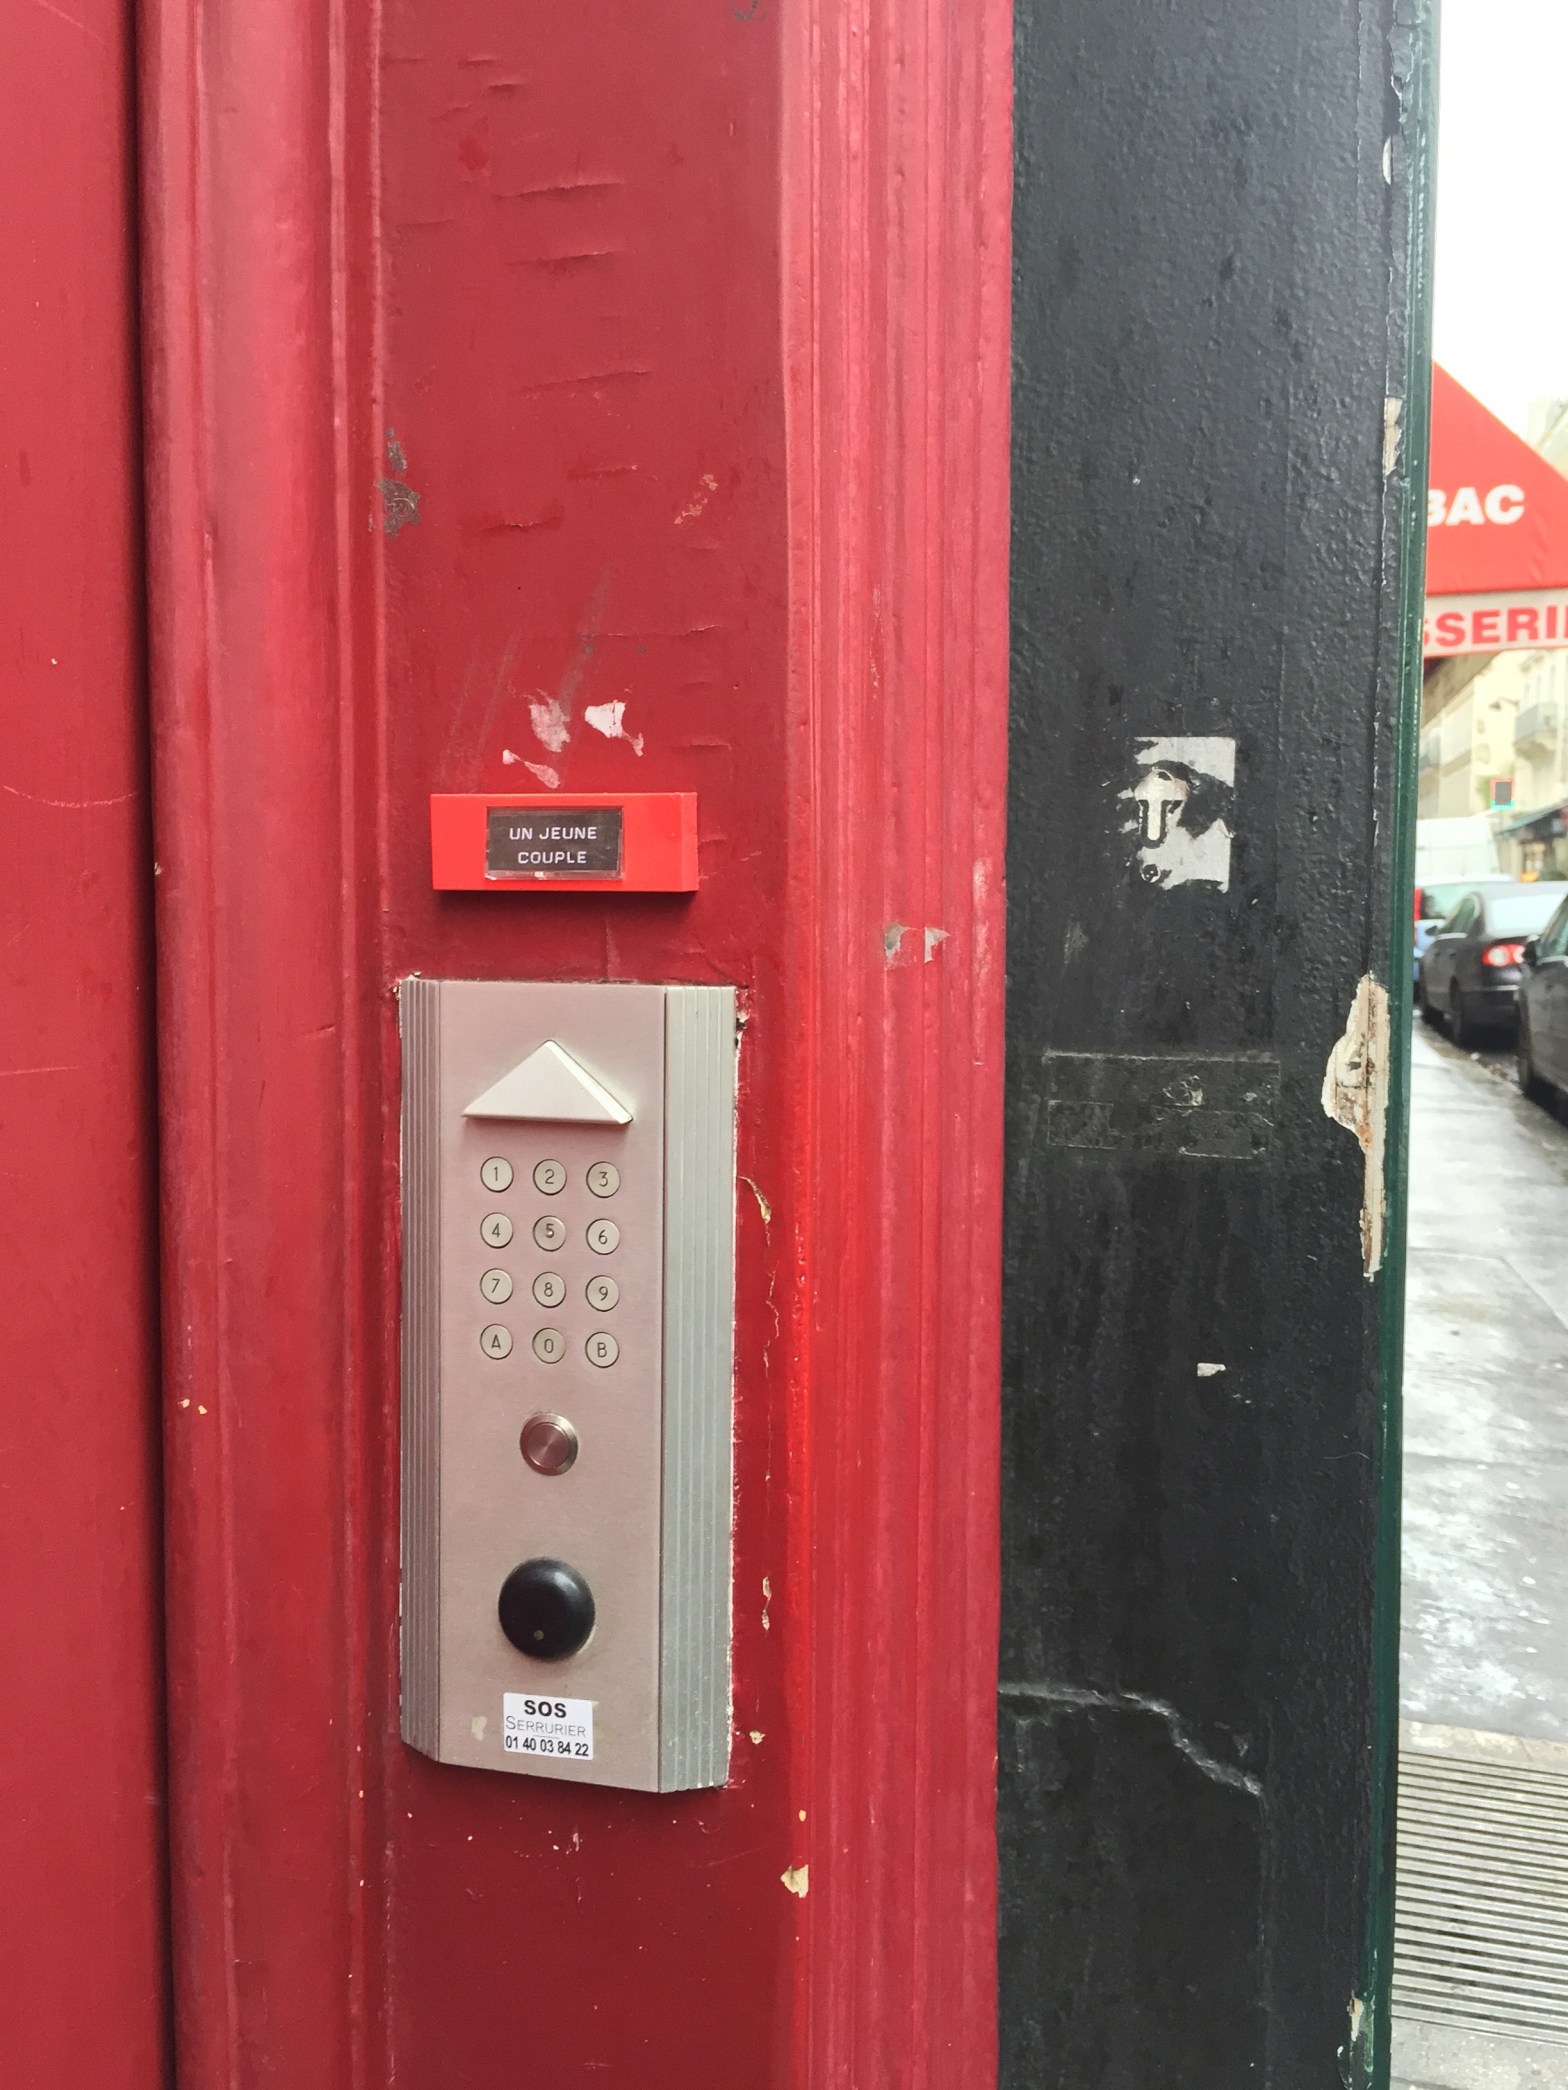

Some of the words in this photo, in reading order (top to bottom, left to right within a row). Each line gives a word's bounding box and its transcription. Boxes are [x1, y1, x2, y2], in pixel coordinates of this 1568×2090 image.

[1423, 604, 1568, 648] SERI
[509, 827, 533, 840] UN
[539, 826, 598, 840] JEUNE
[517, 850, 587, 864] COUPLE
[493, 1166, 499, 1182] 1
[544, 1168, 555, 1185] 2
[598, 1171, 609, 1187] 3
[491, 1222, 501, 1238] 4
[545, 1223, 554, 1239] 5
[598, 1229, 608, 1245] 6
[491, 1278, 501, 1294] 7
[543, 1281, 554, 1298] 8
[598, 1285, 609, 1302] 9
[491, 1334, 502, 1350] A
[597, 1342, 607, 1358] B
[523, 1699, 567, 1719] SOS
[505, 1735, 519, 1750] 01
[522, 1737, 537, 1752] 40
[540, 1739, 554, 1753] 03
[557, 1741, 572, 1755] 84
[574, 1742, 590, 1757] 22
